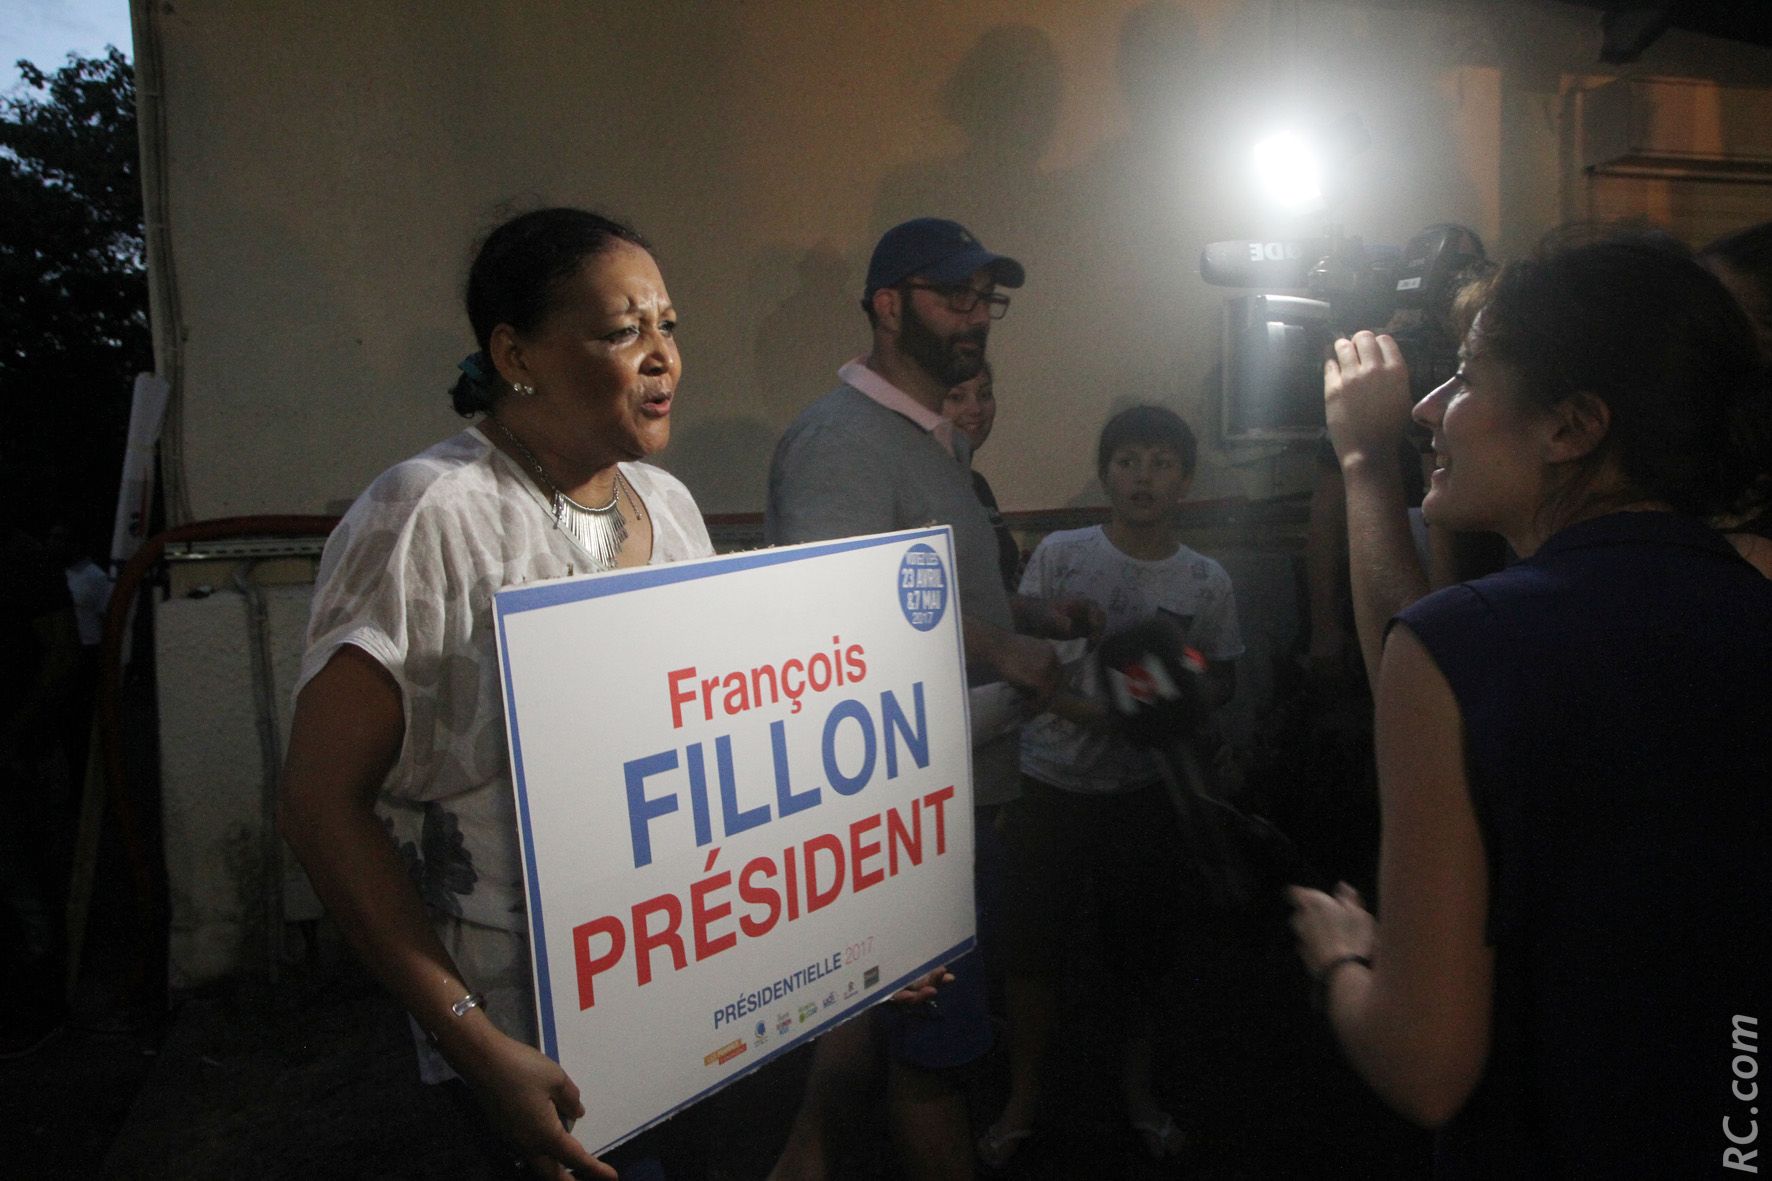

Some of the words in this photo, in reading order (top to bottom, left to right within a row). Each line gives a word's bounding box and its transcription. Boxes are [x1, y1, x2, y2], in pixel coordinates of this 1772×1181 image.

[901, 568, 915, 588] 23
[916, 568, 944, 588] AVRIL
[911, 611, 934, 625] 2017
[922, 590, 942, 610] MAI
[667, 635, 868, 729] François
[623, 681, 931, 869] FILLON
[572, 785, 955, 1012] PRÉSIDENT
[713, 952, 842, 1030] PRÉSIDENTIELLE
[844, 936, 874, 966] 2017
